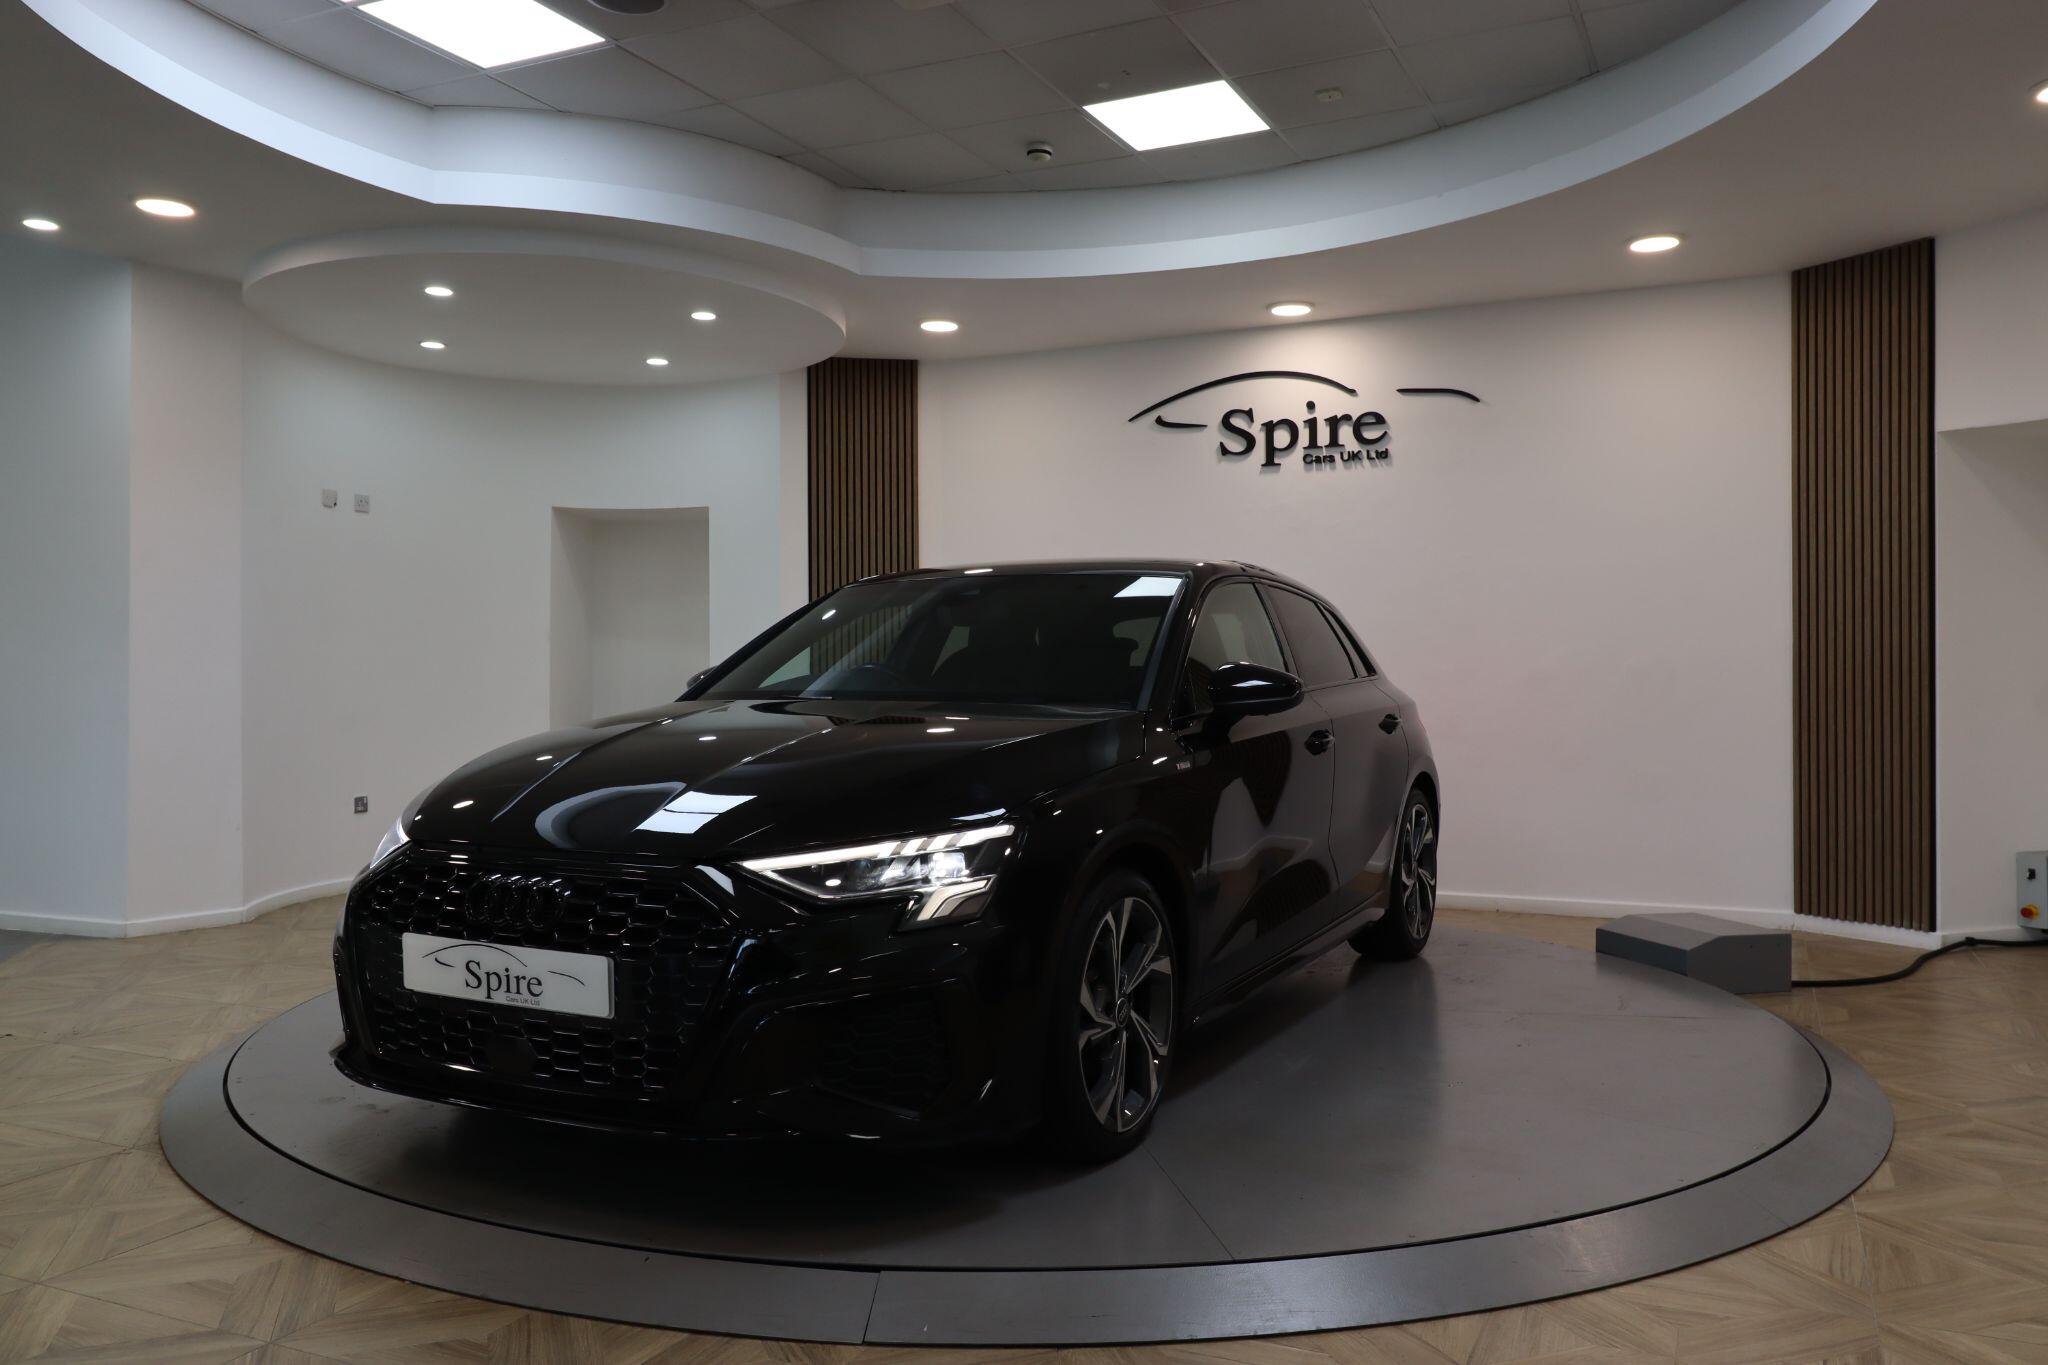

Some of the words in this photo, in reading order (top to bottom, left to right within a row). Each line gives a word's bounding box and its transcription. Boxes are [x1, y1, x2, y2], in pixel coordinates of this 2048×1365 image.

[1219, 401, 1387, 466] Spire
[1302, 453, 1336, 465] Cars
[1340, 450, 1362, 462] UK
[1366, 448, 1389, 460] Ltd
[464, 960, 544, 999] Spire
